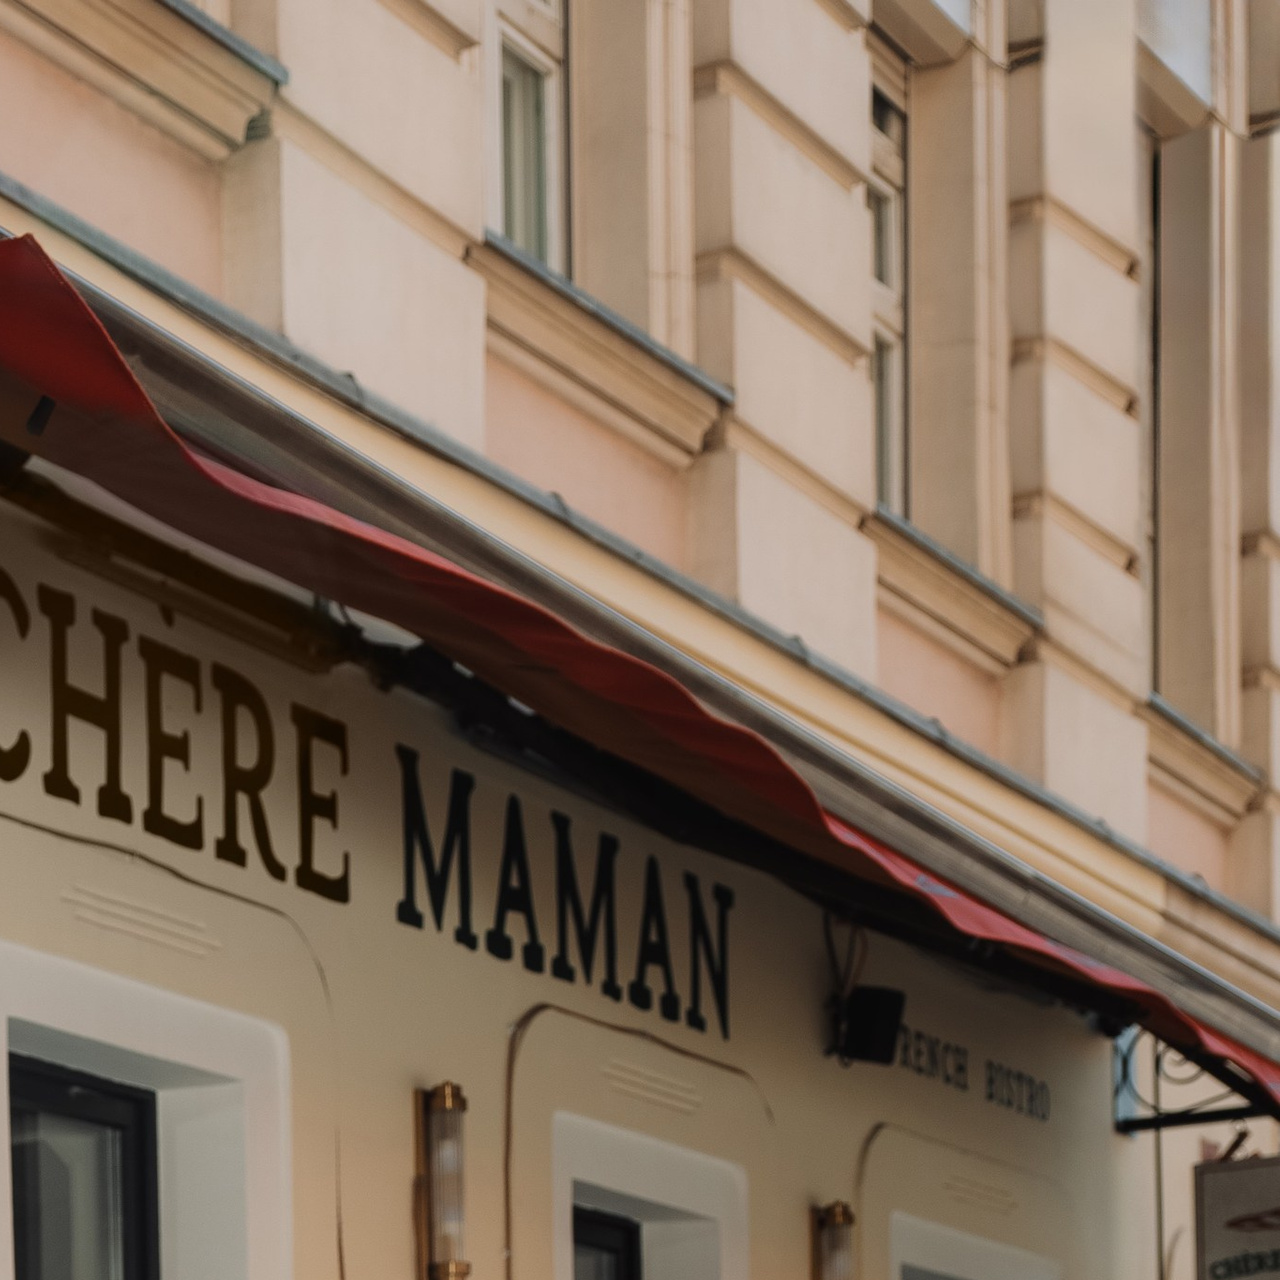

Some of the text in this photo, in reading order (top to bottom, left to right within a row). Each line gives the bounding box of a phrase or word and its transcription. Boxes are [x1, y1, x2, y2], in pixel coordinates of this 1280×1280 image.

[395, 742, 735, 1041] MAMAN
[898, 1022, 1051, 1122] RENCH BISTRO
